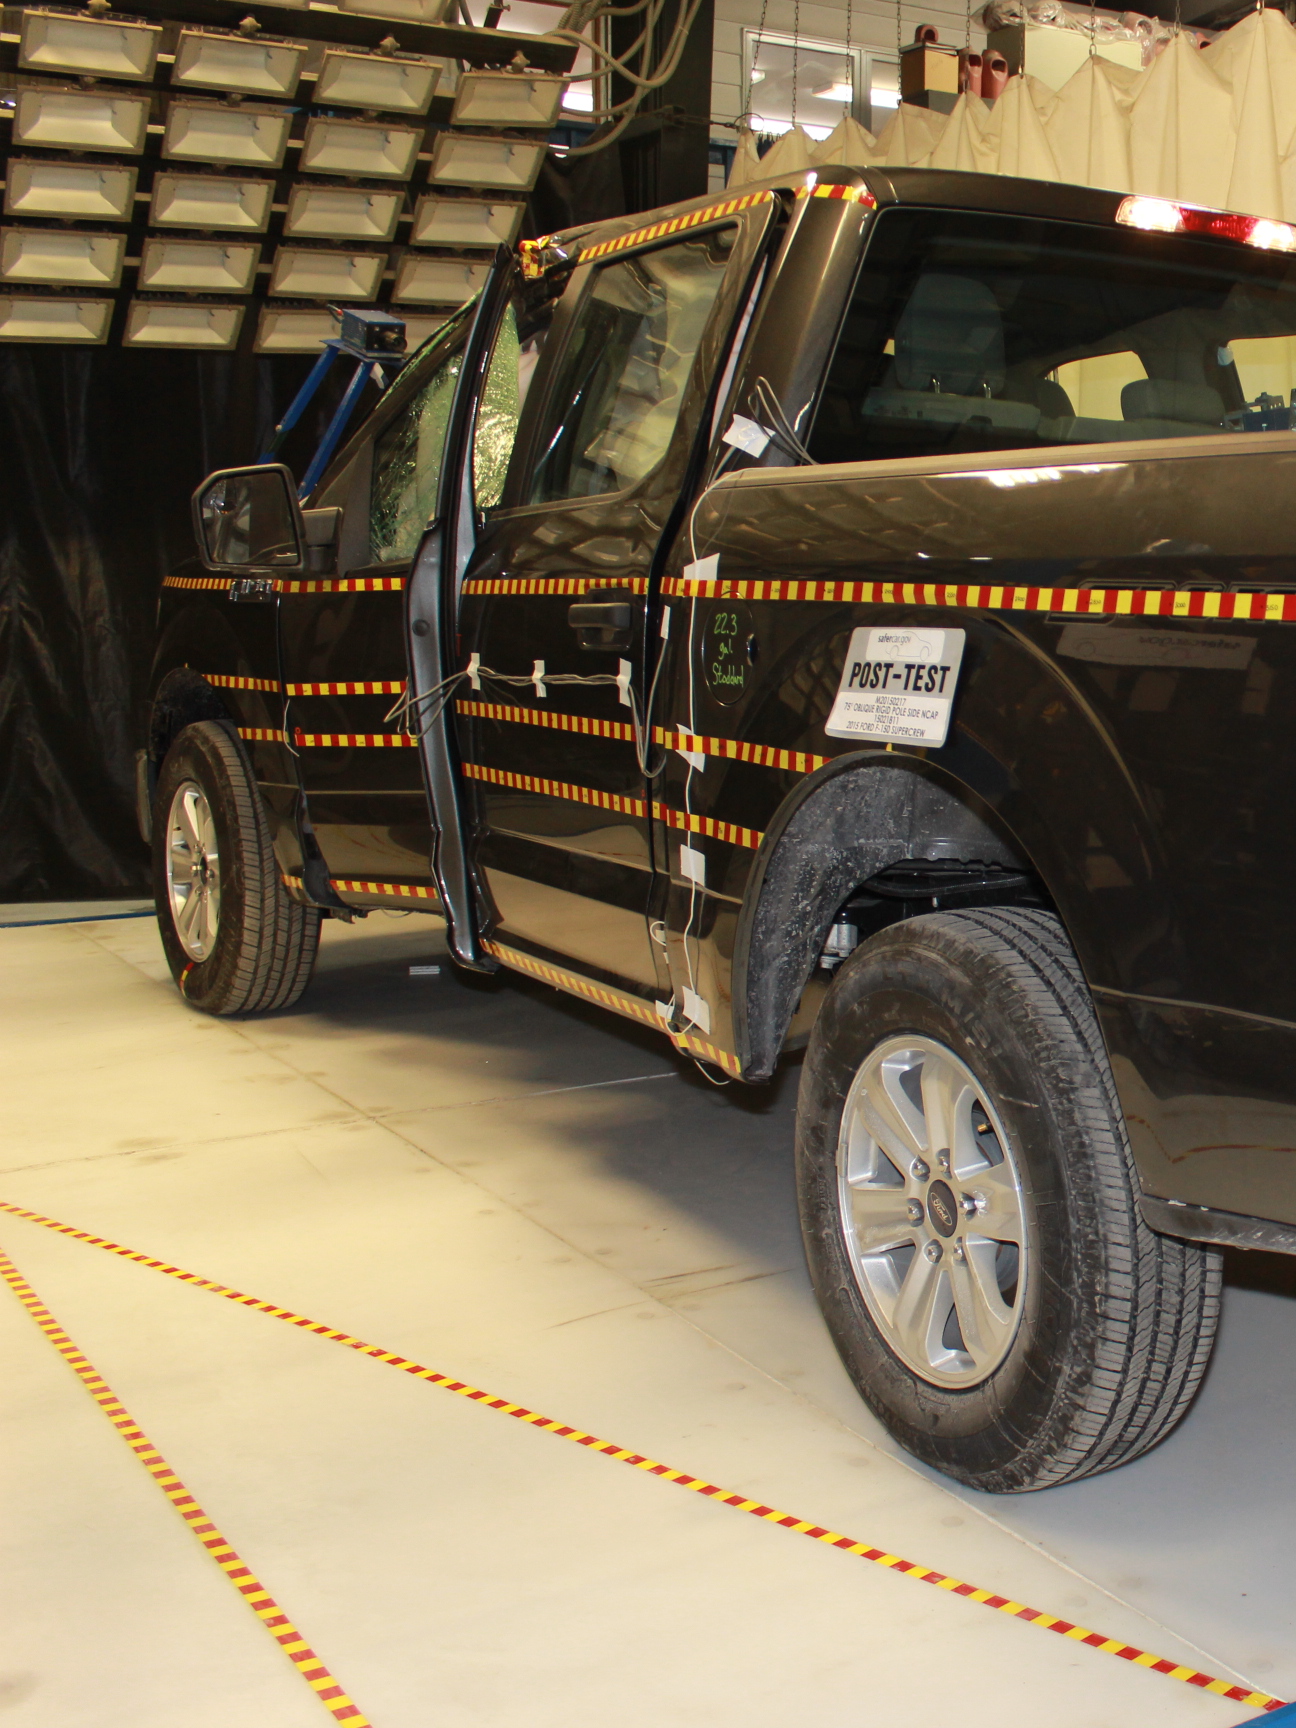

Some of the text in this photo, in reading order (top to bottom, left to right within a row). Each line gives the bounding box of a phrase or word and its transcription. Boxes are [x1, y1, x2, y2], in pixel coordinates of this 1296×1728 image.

[714, 612, 738, 636] 22.3
[878, 633, 911, 645] safercar.gov
[848, 661, 951, 693] POST-TEST
[853, 703, 875, 713] OBLIQUE
[876, 705, 891, 715] RIGID
[892, 706, 907, 716] POLE
[908, 708, 921, 718] SIDE
[921, 710, 939, 720] NCAP
[846, 721, 860, 730] 2015
[860, 722, 875, 731] FORD
[891, 725, 925, 737] SUPERCREW
